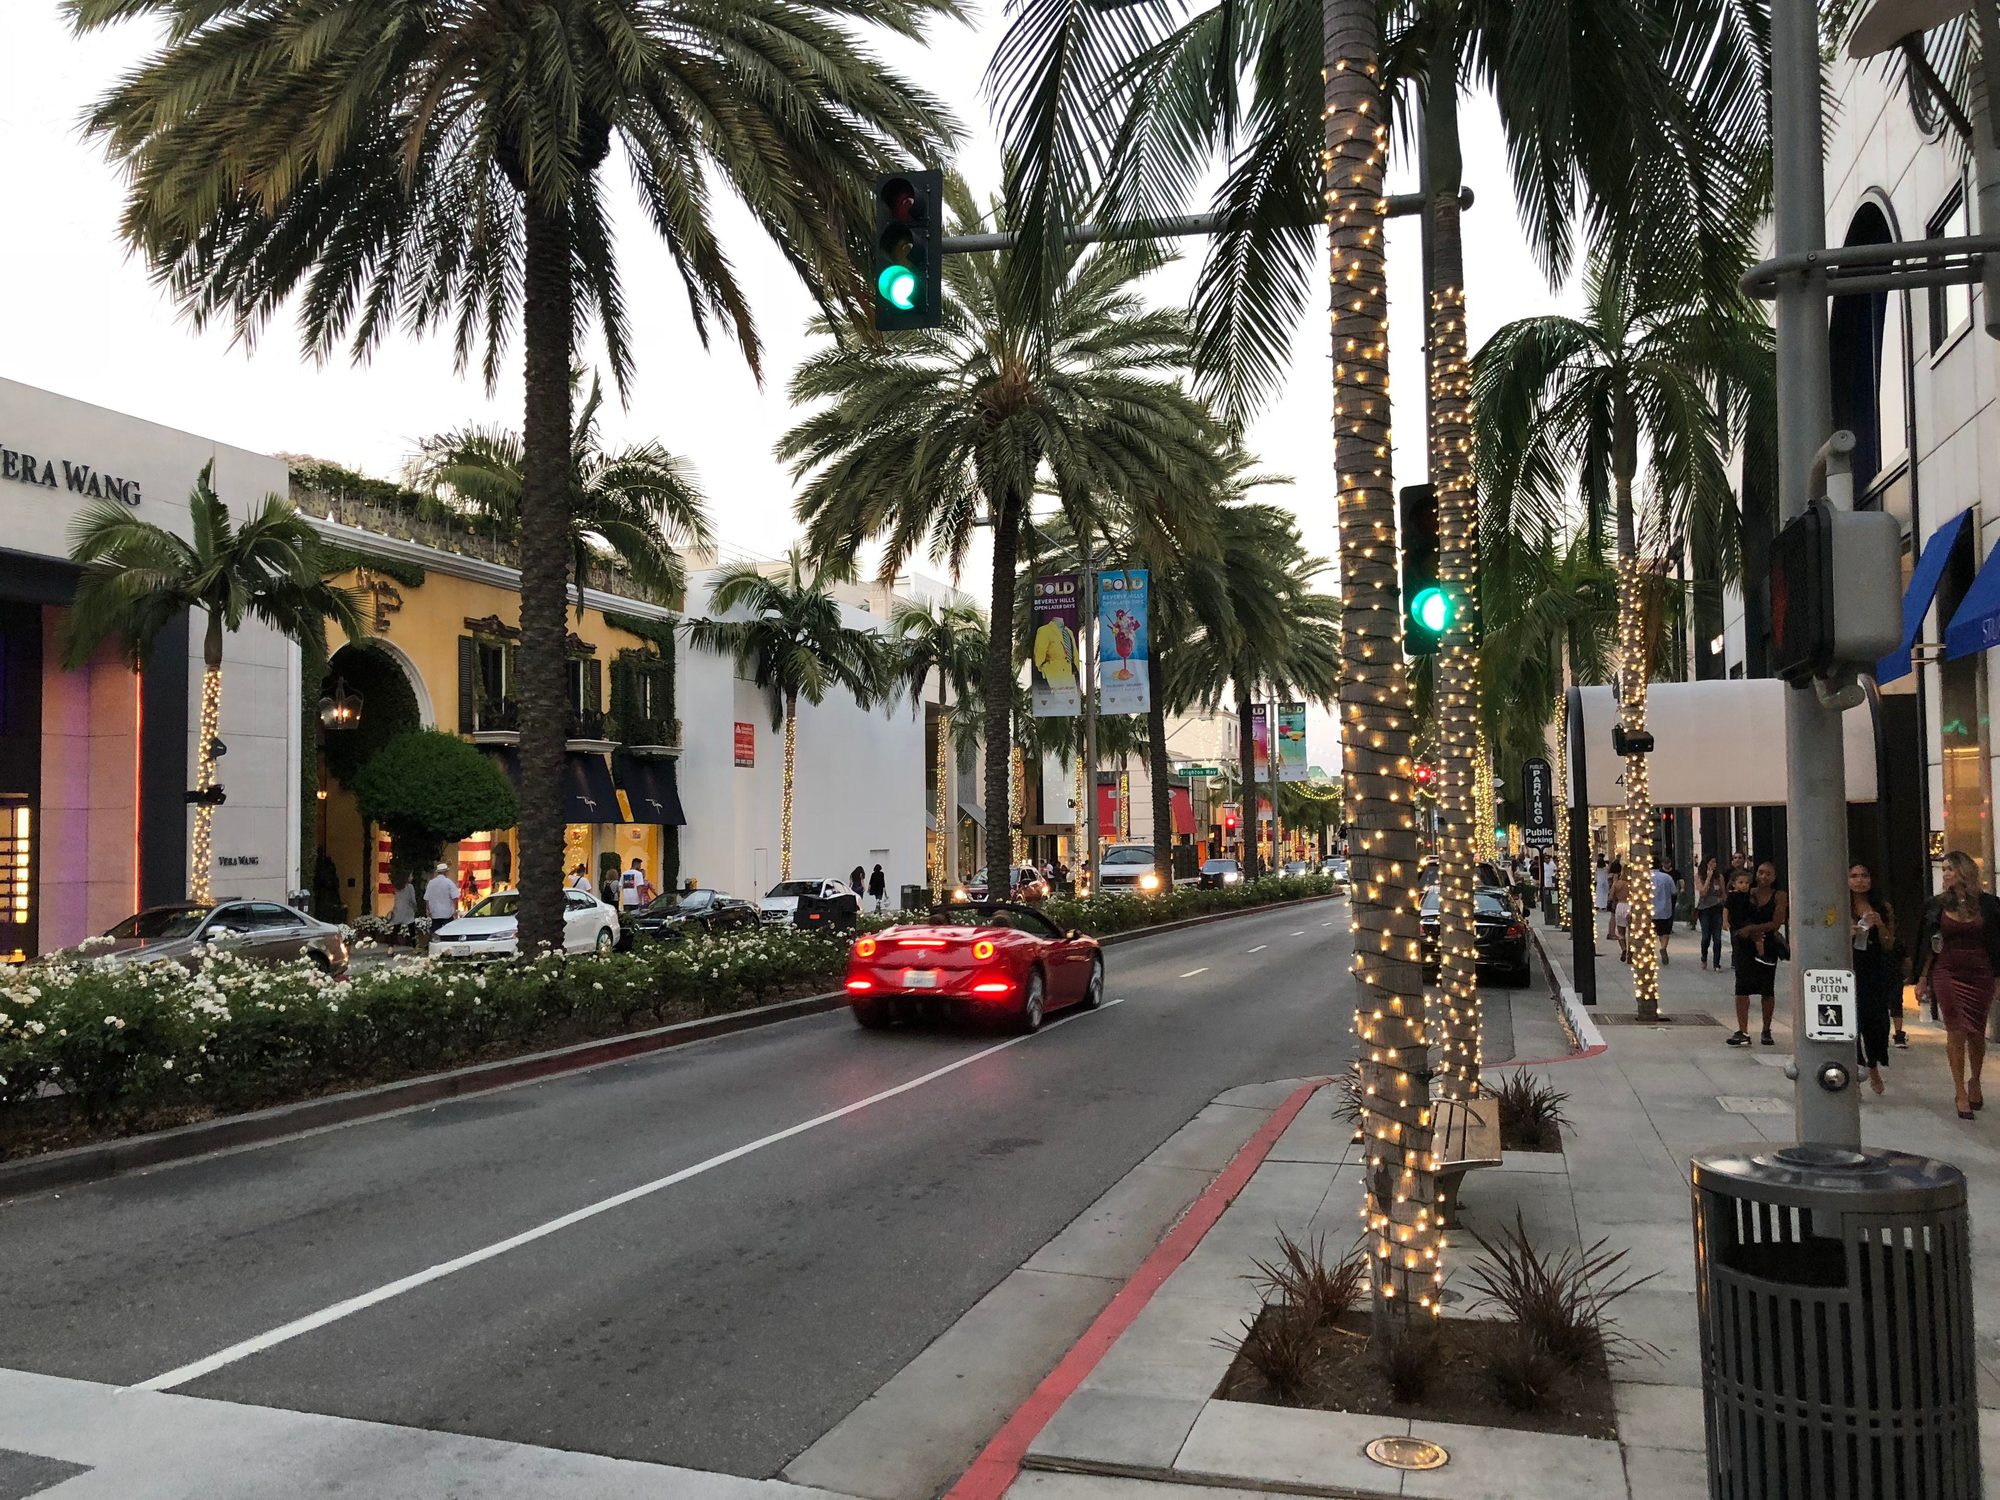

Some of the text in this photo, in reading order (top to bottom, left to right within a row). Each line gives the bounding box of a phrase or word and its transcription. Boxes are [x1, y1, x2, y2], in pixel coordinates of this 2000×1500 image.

[0, 444, 142, 506] ERA WANG
[1034, 581, 1075, 597] BOLD
[1532, 769, 1543, 815] PARKING
[1525, 828, 1553, 837] Public
[1526, 836, 1553, 844] Parking
[218, 855, 259, 866] VERA WANG
[1815, 976, 1842, 985] PUSH
[1810, 985, 1848, 993] BUTTON
[1820, 994, 1839, 1002] FOR
